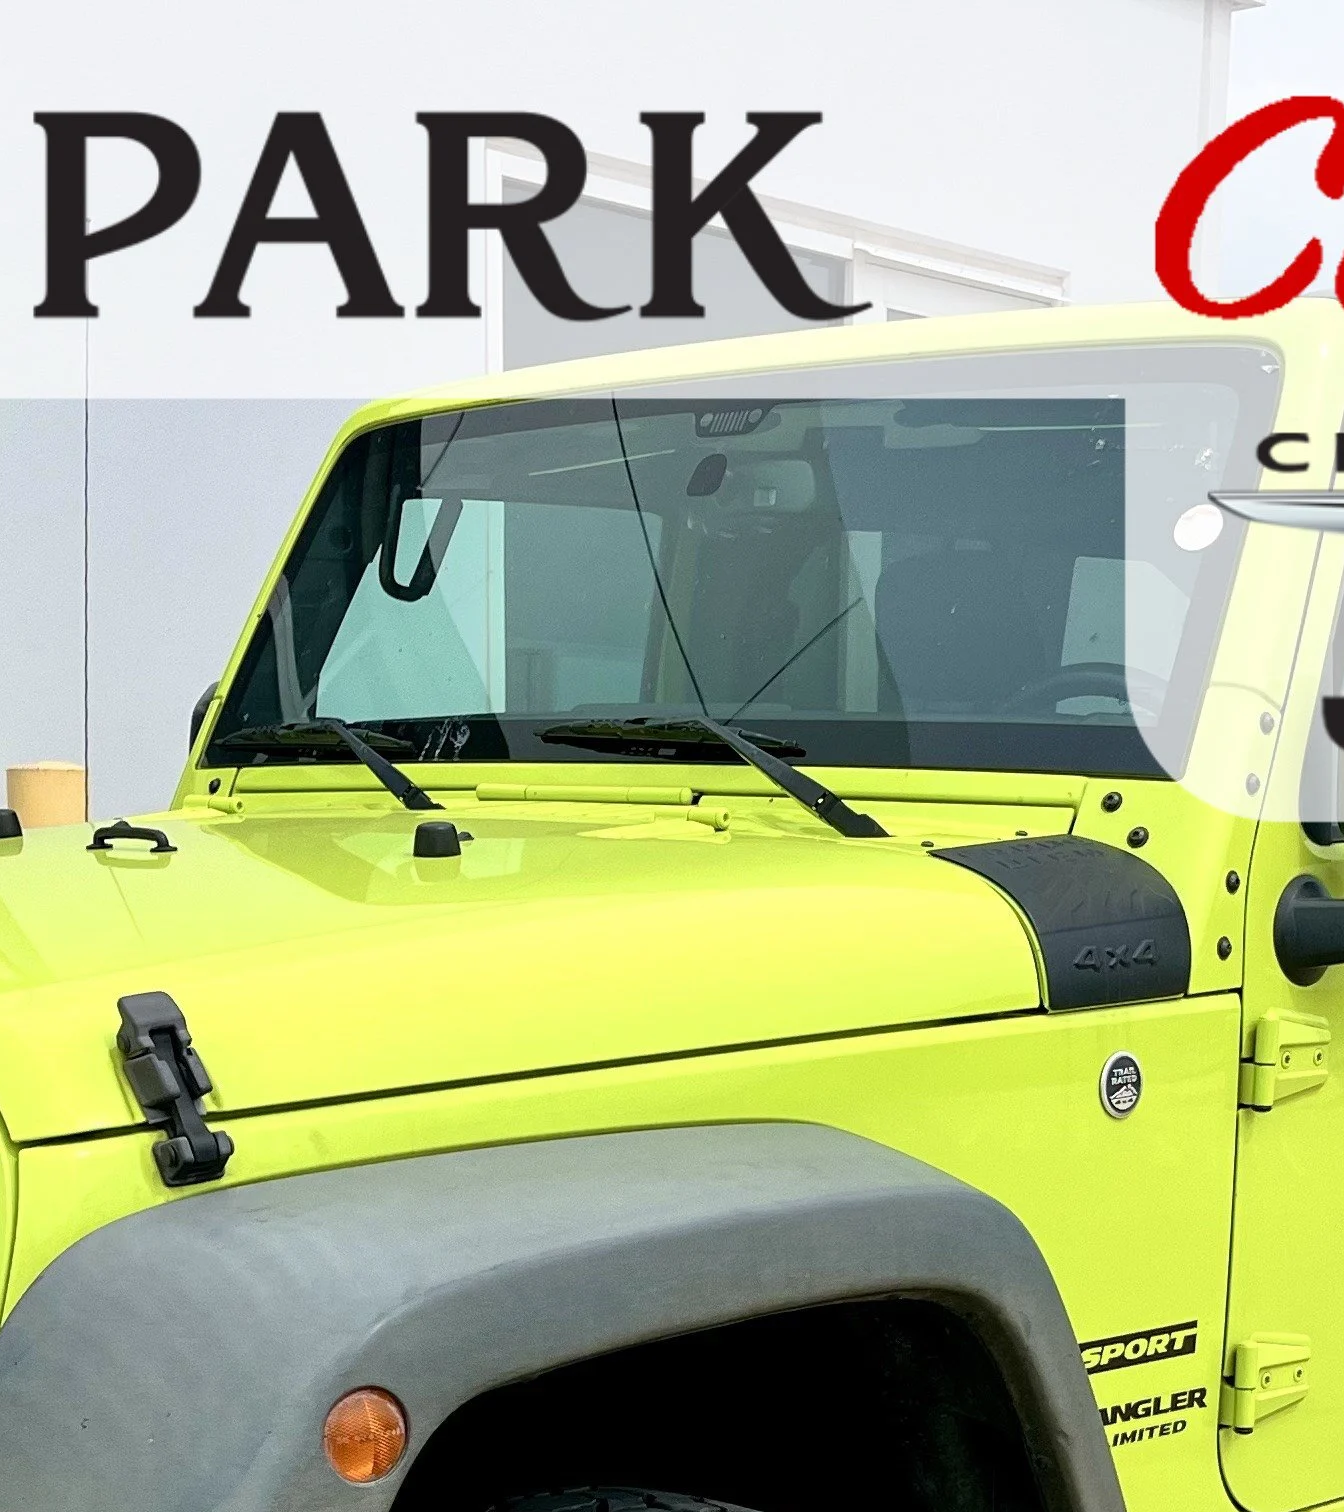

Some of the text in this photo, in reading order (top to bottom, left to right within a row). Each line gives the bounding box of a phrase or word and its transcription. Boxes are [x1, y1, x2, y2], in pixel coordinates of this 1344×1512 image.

[1080, 1327, 1198, 1370] SPORT
[1098, 1387, 1208, 1427] ANGLER
[1109, 1419, 1188, 1448] IMITED
